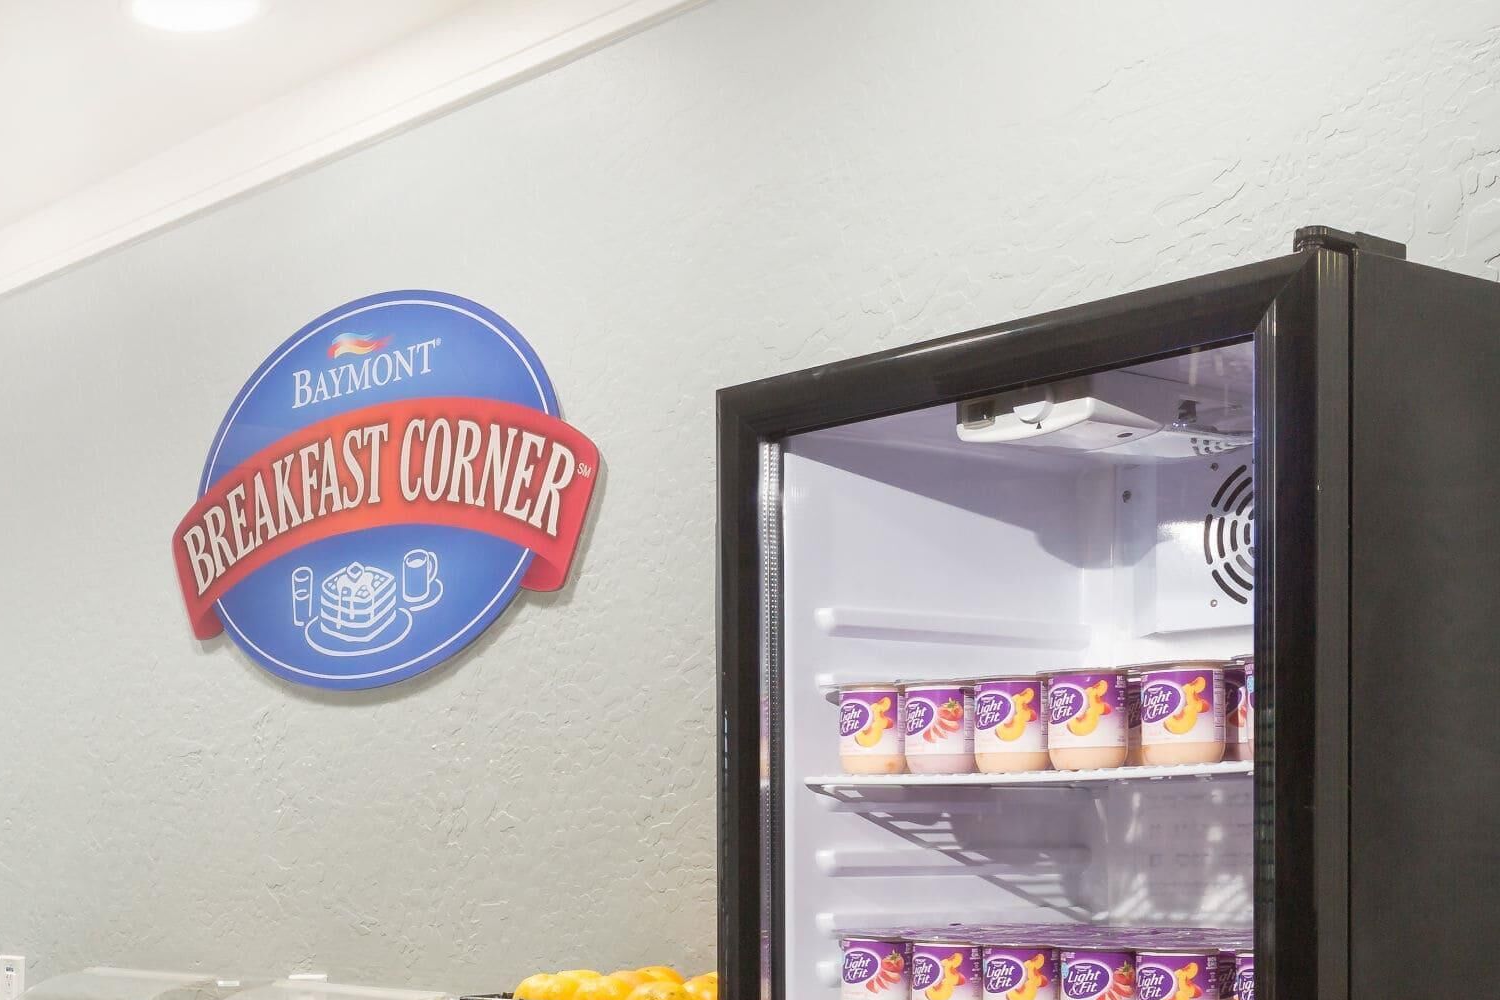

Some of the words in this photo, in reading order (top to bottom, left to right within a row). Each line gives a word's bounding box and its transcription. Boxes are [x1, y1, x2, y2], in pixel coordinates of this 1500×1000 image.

[292, 339, 437, 409] BAYMONT
[183, 422, 389, 596] BREAKFAST
[400, 417, 576, 537] CORNER
[1144, 690, 1172, 707] Light
[986, 965, 1015, 980] Light
[1068, 969, 1101, 985] Light
